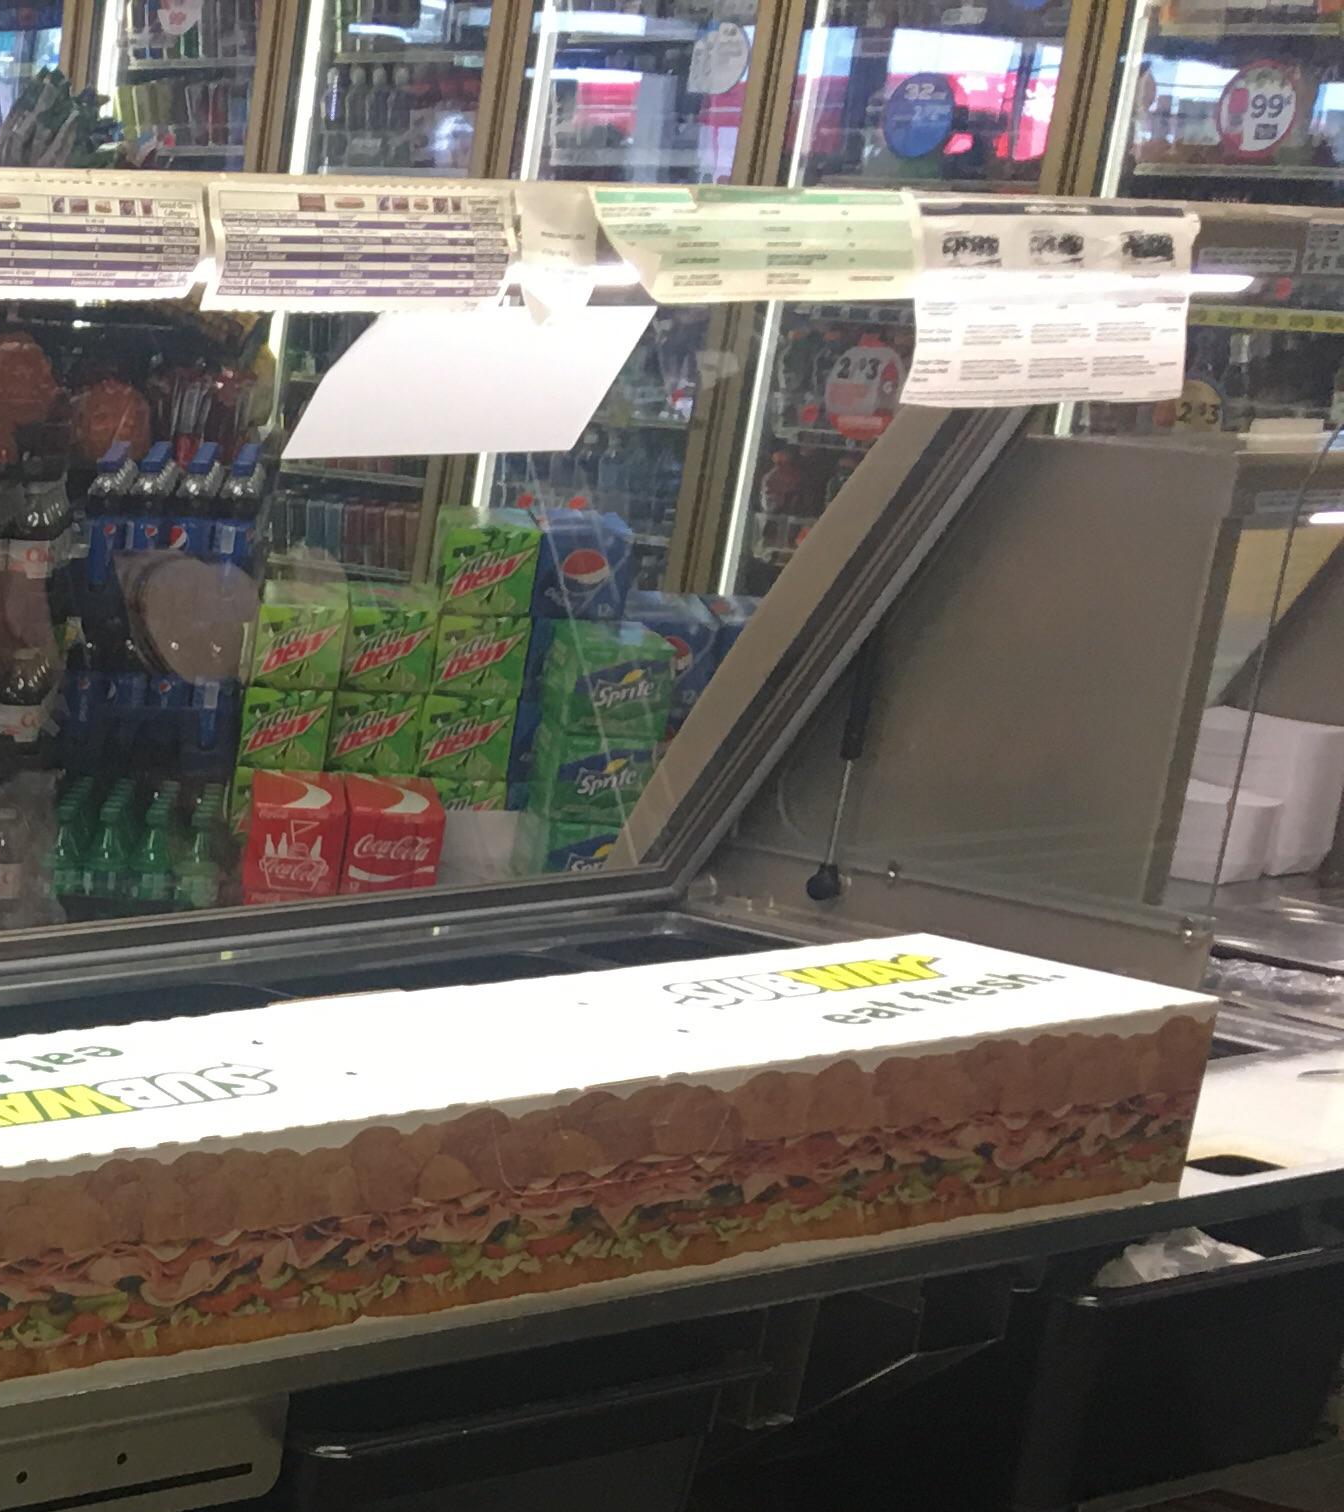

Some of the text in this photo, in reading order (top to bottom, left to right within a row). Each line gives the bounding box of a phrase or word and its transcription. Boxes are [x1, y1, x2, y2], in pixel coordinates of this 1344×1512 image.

[593, 675, 656, 709] Sprite
[576, 767, 638, 795] Sprite
[353, 834, 436, 862] Coca-Cola
[663, 954, 946, 1009] SUBWAY
[822, 968, 1067, 1025] eat fresh.
[6, 1044, 124, 1074] eat
